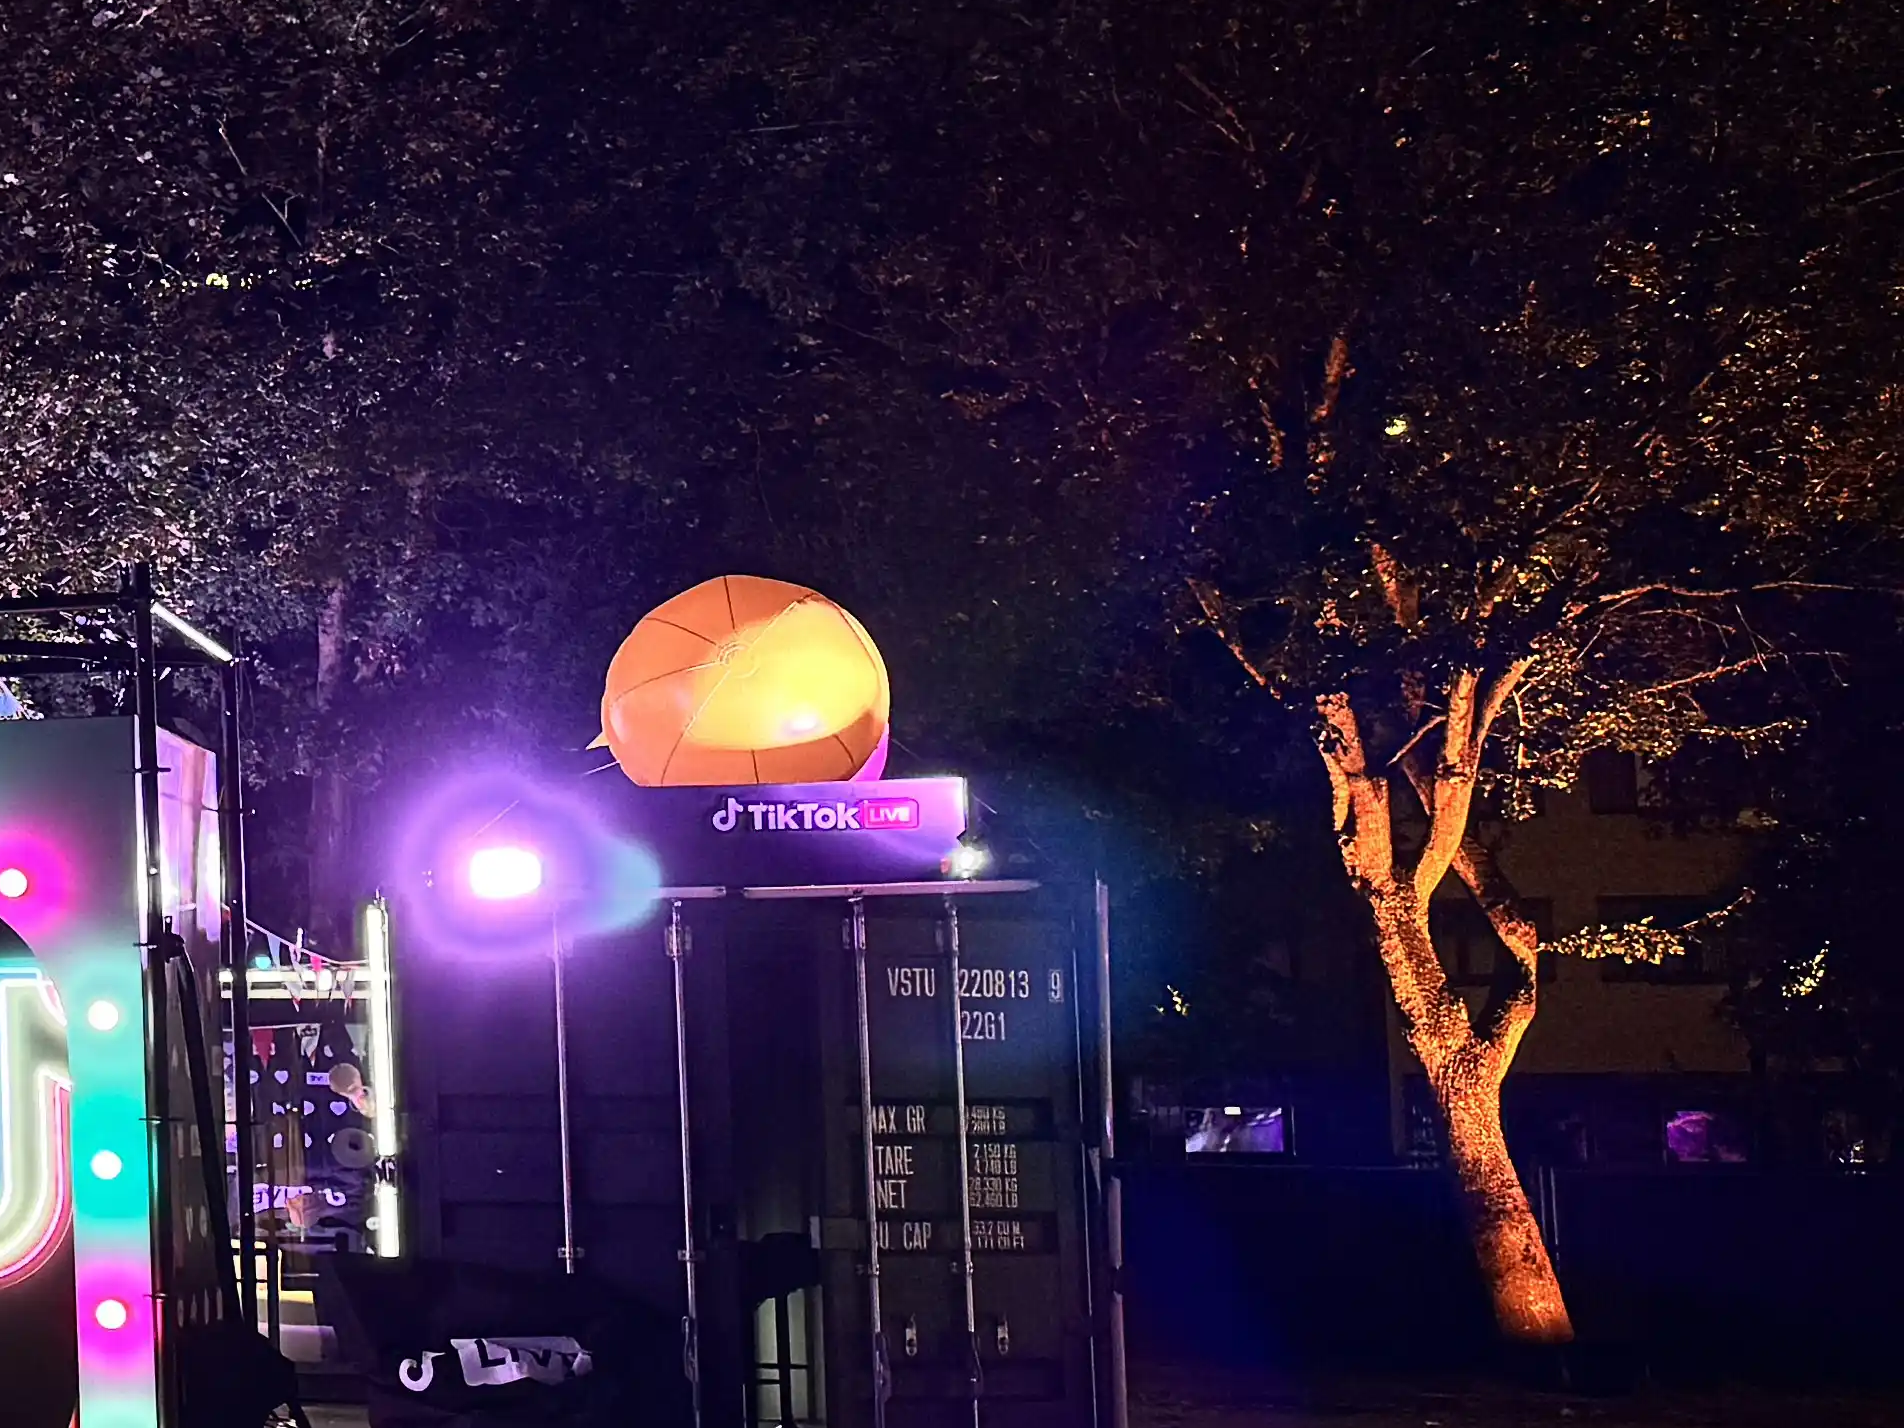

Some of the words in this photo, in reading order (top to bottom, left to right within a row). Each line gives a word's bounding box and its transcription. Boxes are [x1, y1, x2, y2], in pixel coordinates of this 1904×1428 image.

[747, 801, 861, 831] TikTok
[869, 806, 911, 823] LIVE
[887, 968, 935, 997] VSTU
[959, 969, 1030, 998] 220813
[1050, 971, 1062, 1000] 9
[960, 1010, 1006, 1041] 22G1
[874, 1145, 914, 1176] TARE
[876, 1179, 907, 1209] NET
